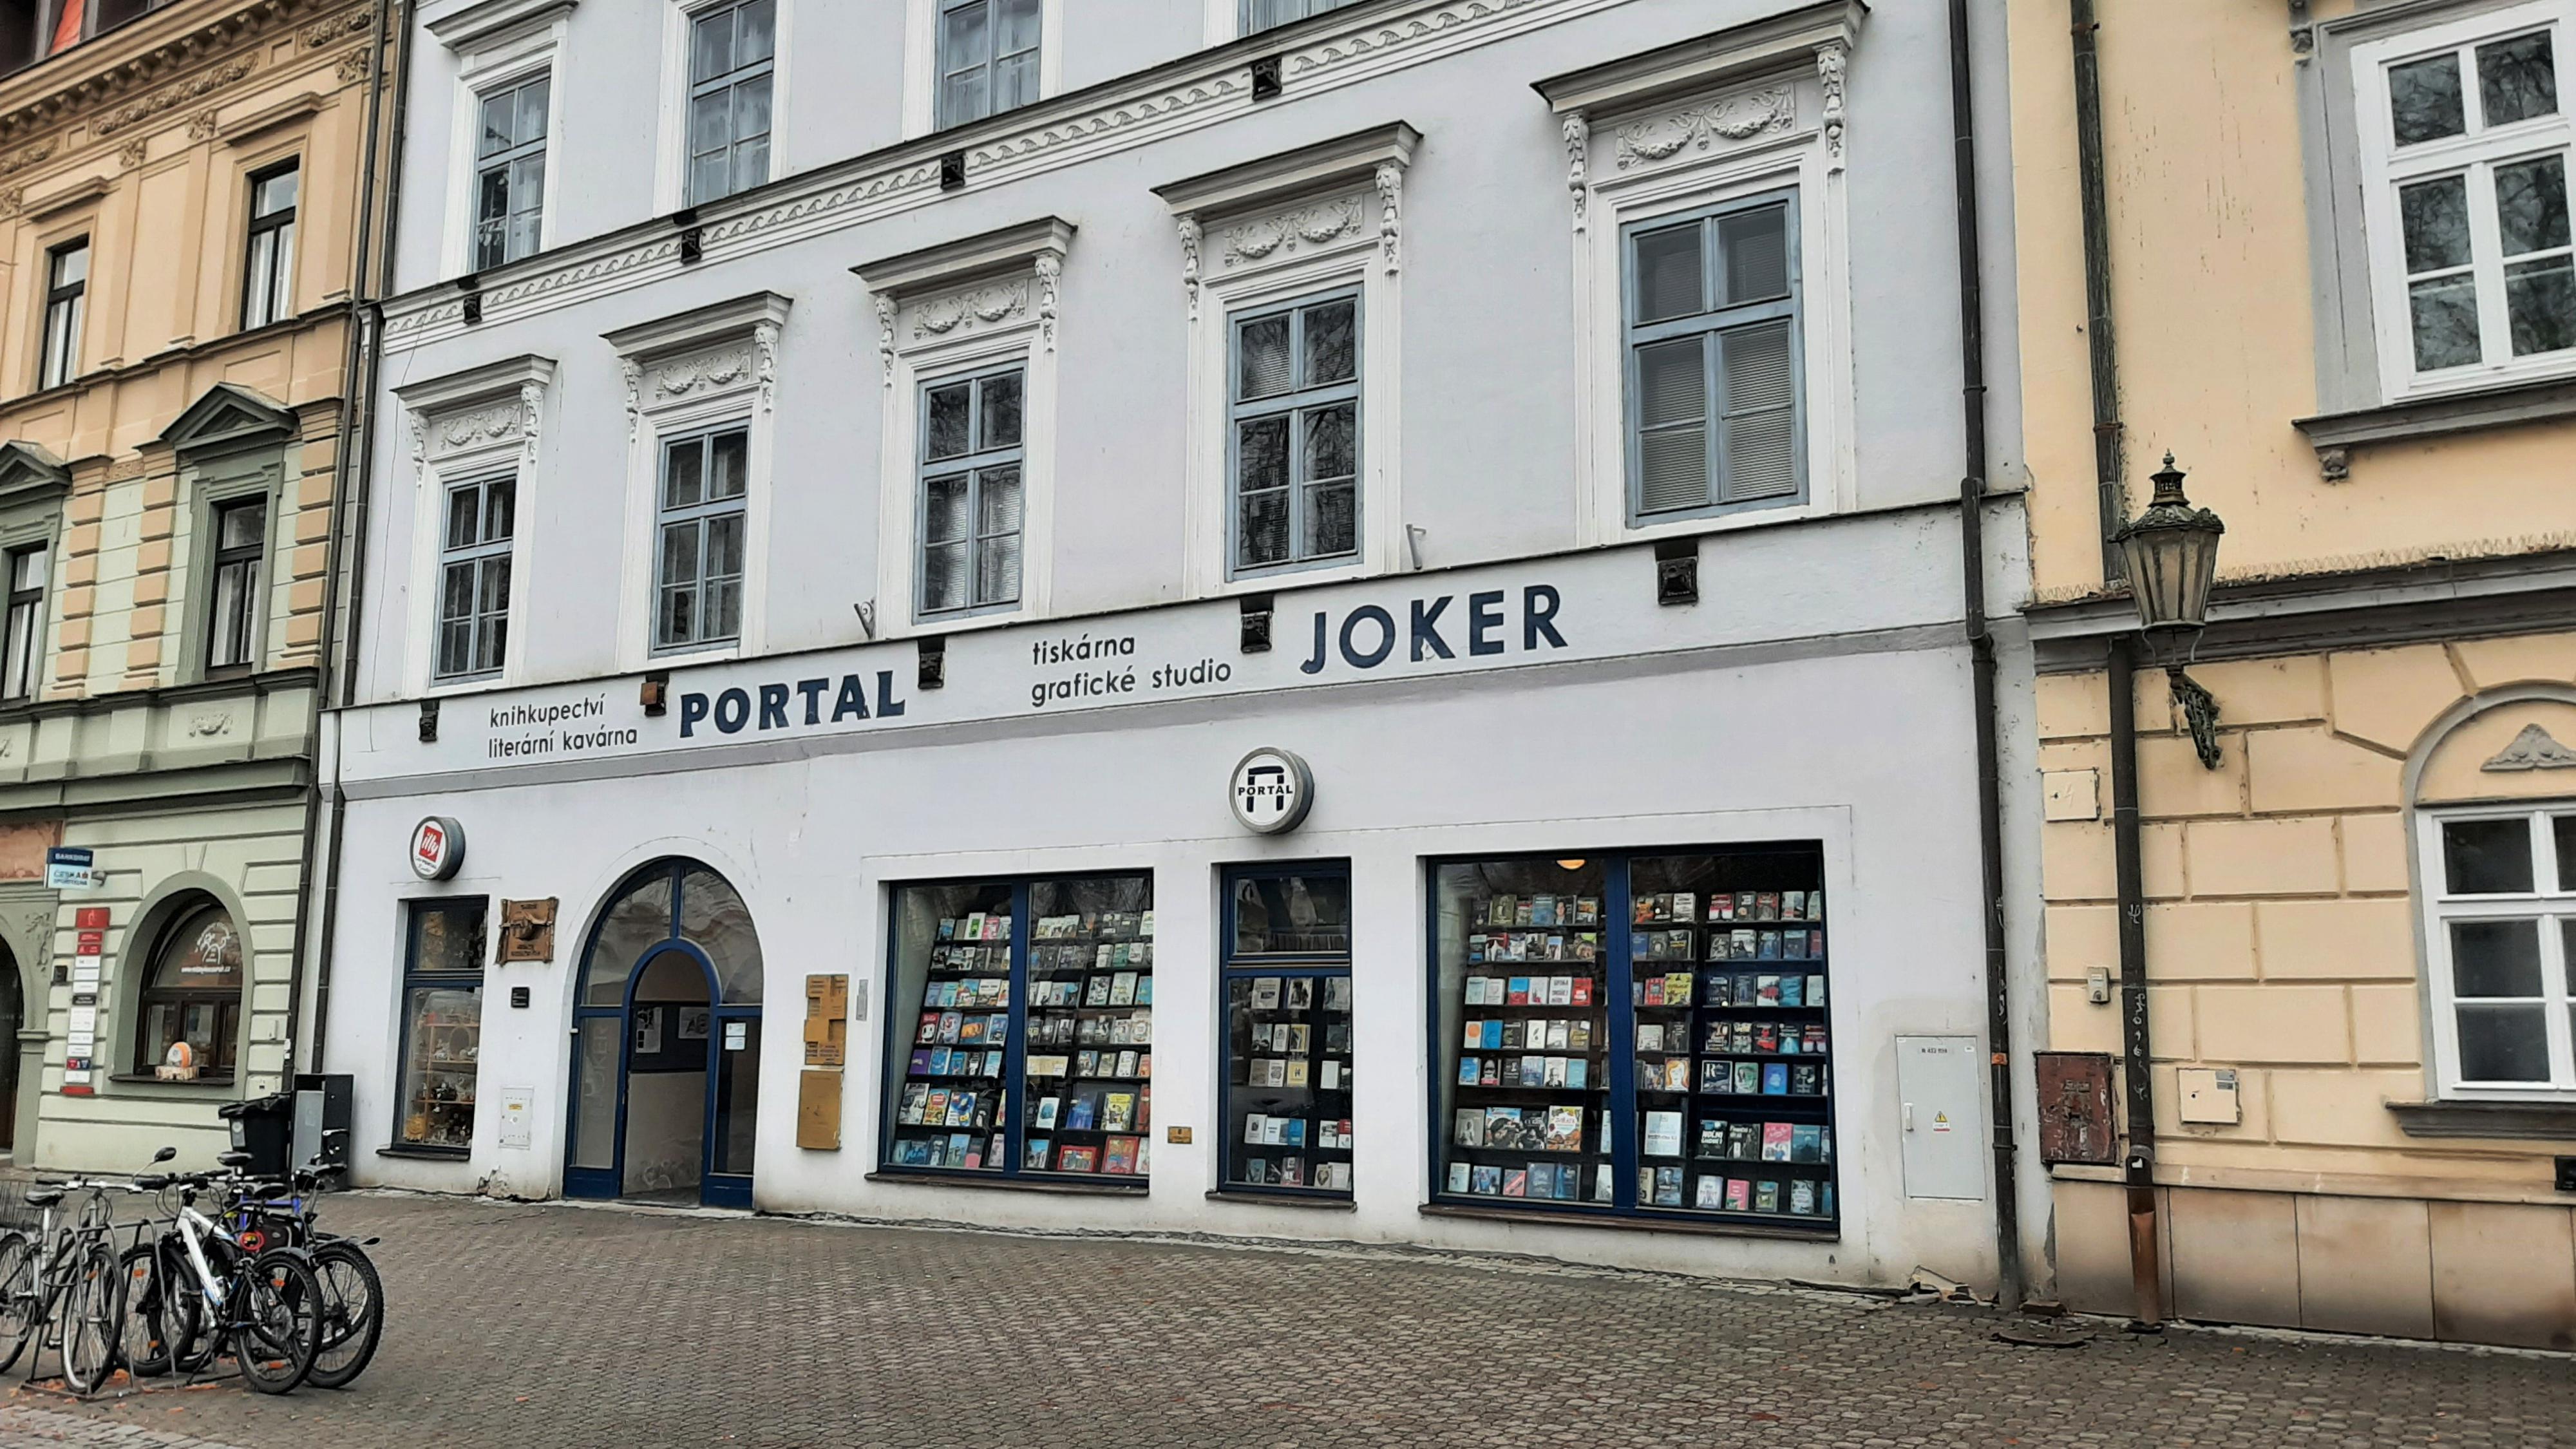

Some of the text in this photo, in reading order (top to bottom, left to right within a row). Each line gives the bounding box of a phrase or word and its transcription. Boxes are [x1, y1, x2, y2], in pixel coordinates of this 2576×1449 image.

[1300, 583, 1569, 675] JOKER
[1032, 633, 1135, 665] tiskárna
[1031, 658, 1231, 708] grafické studio
[489, 693, 605, 728] knihkupectví
[679, 670, 906, 739] PORTAL
[488, 724, 638, 759] literární kavárna
[1238, 785, 1293, 796] PORTAL
[421, 831, 439, 857] illy
